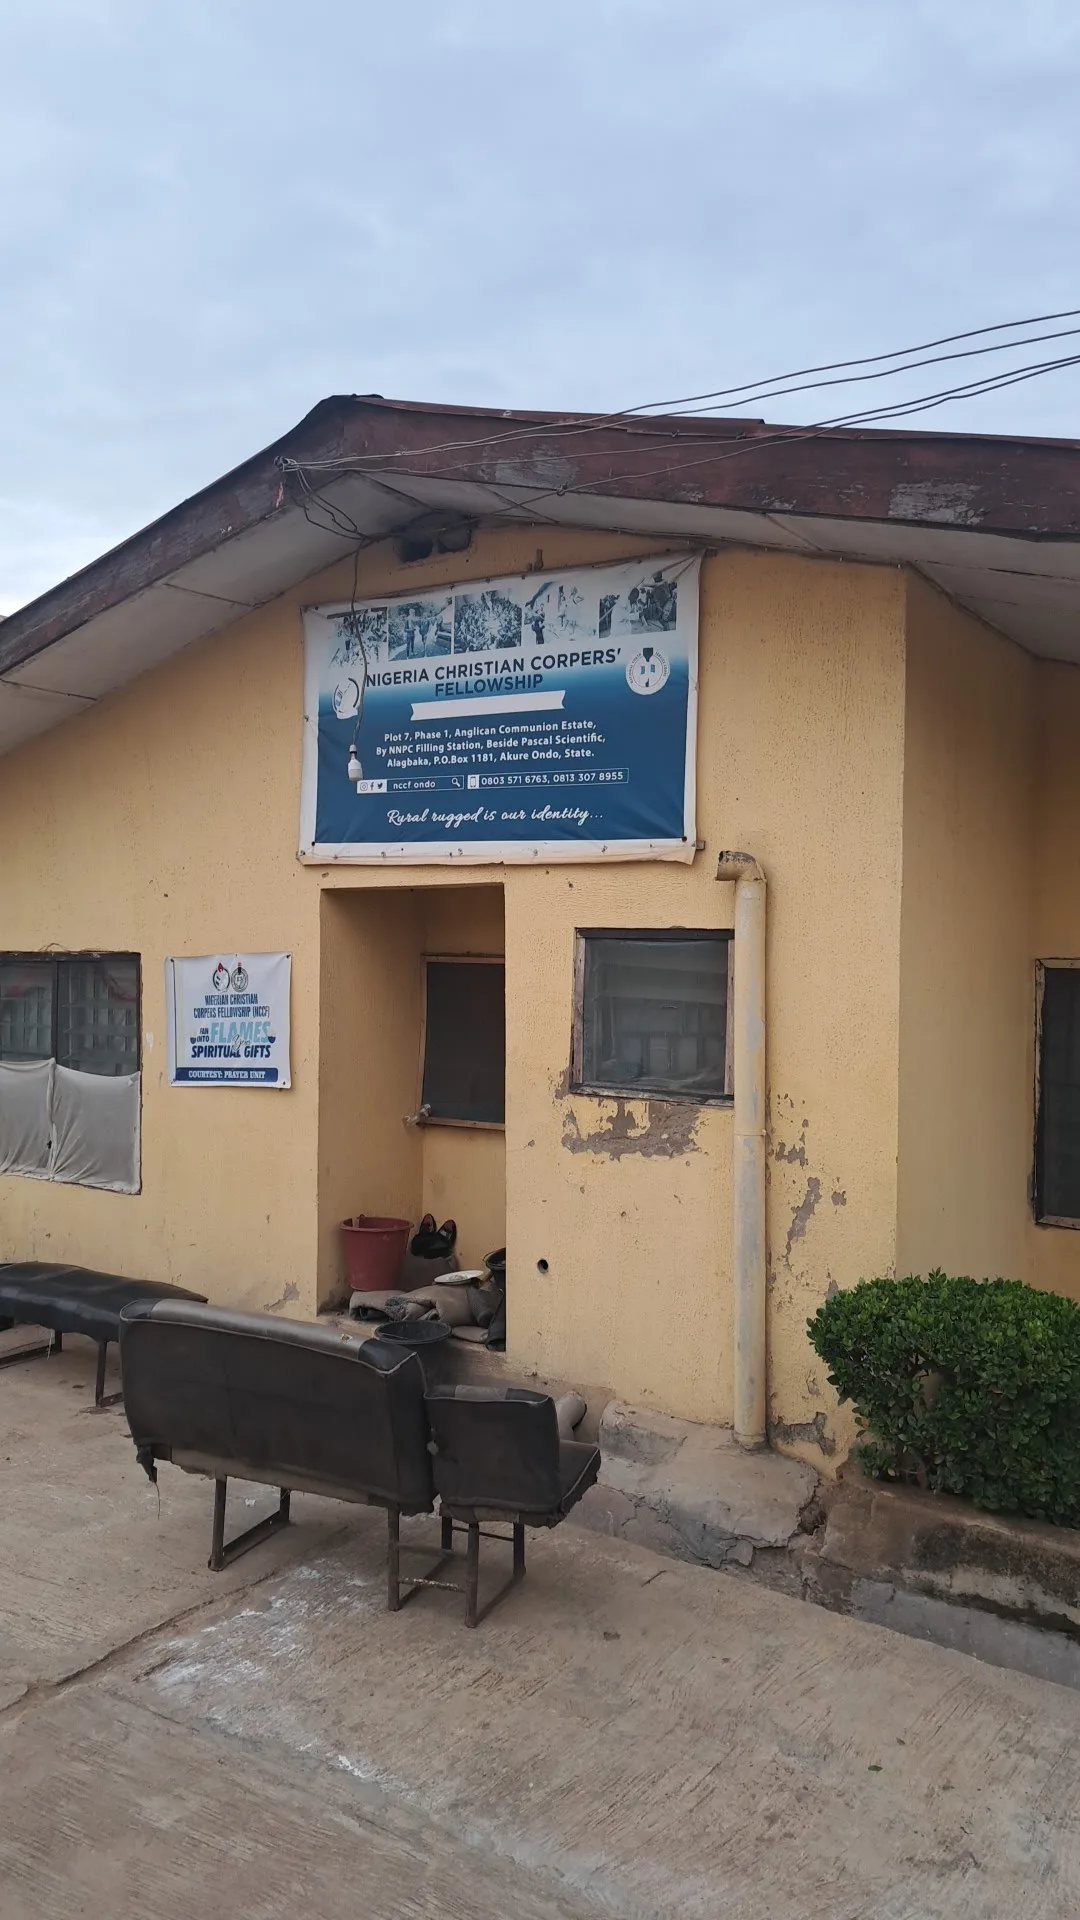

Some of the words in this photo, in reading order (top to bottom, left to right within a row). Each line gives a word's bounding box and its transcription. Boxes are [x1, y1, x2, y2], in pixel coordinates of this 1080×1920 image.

[366, 668, 430, 688] NIGERIA
[434, 658, 525, 681] CHRISTIAN
[530, 647, 622, 671] CORPERS'
[435, 673, 544, 697] FELLOWSHIP
[384, 733, 402, 742] Plot
[404, 732, 413, 741] 7,
[414, 730, 441, 740] Phase
[444, 729, 452, 739] 1,
[454, 726, 496, 738] Anglican
[498, 721, 559, 734] Communion
[561, 719, 597, 730] Estate,
[376, 746, 387, 757] By
[388, 744, 414, 755] NNPC
[415, 742, 445, 753] Filling
[446, 740, 484, 751] Station,
[486, 737, 519, 749] Beside
[521, 735, 553, 747] Pascal
[555, 732, 606, 745] Scientific,
[387, 757, 431, 769] Alagbaka,
[433, 754, 469, 765] P.O.Box
[471, 752, 497, 763] 1181,
[500, 751, 529, 761] Akure
[531, 749, 562, 760] Ondo,
[564, 747, 595, 758] State.
[393, 781, 412, 790] nccf
[413, 780, 436, 789] ondo
[481, 776, 505, 786] 0803
[507, 775, 522, 785] 571
[525, 774, 550, 785] 6763,
[553, 773, 575, 783] 0813
[578, 772, 596, 782] 307
[598, 771, 624, 781] 8955
[387, 808, 430, 826] Rural
[431, 806, 485, 829] rugged
[483, 808, 497, 821] is
[501, 810, 527, 821] our
[204, 994, 229, 1006] NIGERIAN
[229, 993, 259, 1005] CHRISTIAN
[193, 1007, 217, 1019] CORPERS
[217, 1006, 251, 1018] FELLOWSHIP
[199, 1027, 209, 1035] FAN
[210, 1021, 271, 1043] FLAMES
[196, 1035, 210, 1043] INTO
[191, 1045, 241, 1058] SPIRITUAL
[244, 1045, 272, 1058] GIFTS
[224, 1070, 249, 1079] PRAYER
[249, 1070, 266, 1079] UNIT
